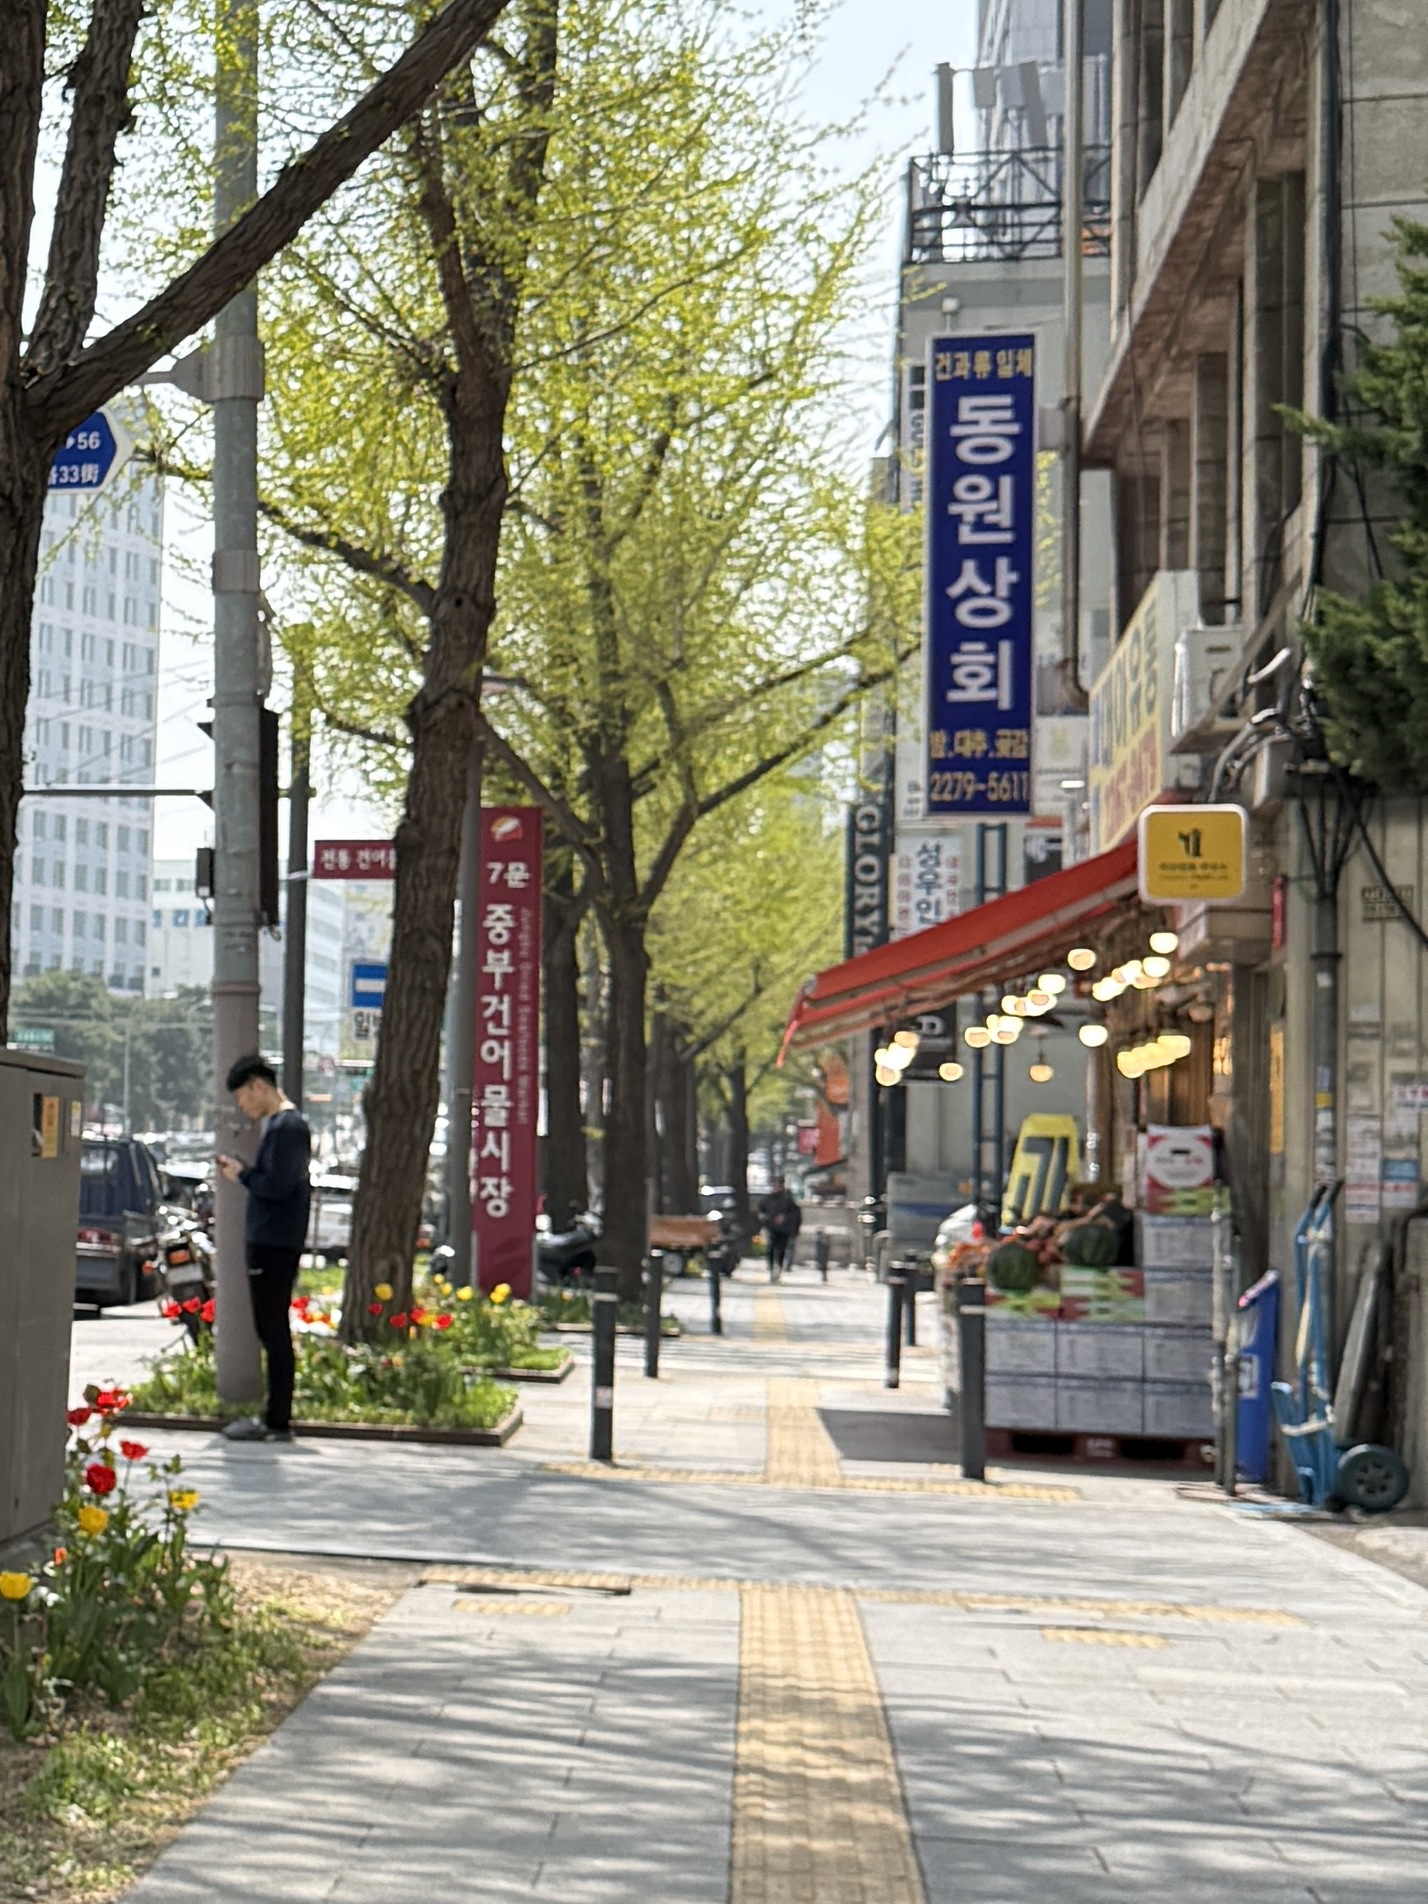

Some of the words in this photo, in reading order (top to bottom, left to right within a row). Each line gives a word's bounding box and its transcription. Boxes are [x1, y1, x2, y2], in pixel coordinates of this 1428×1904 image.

[77, 431, 101, 450] 56
[945, 393, 1024, 712] 동원상회
[930, 771, 1029, 802] 2279-5611
[487, 861, 533, 889] 7문
